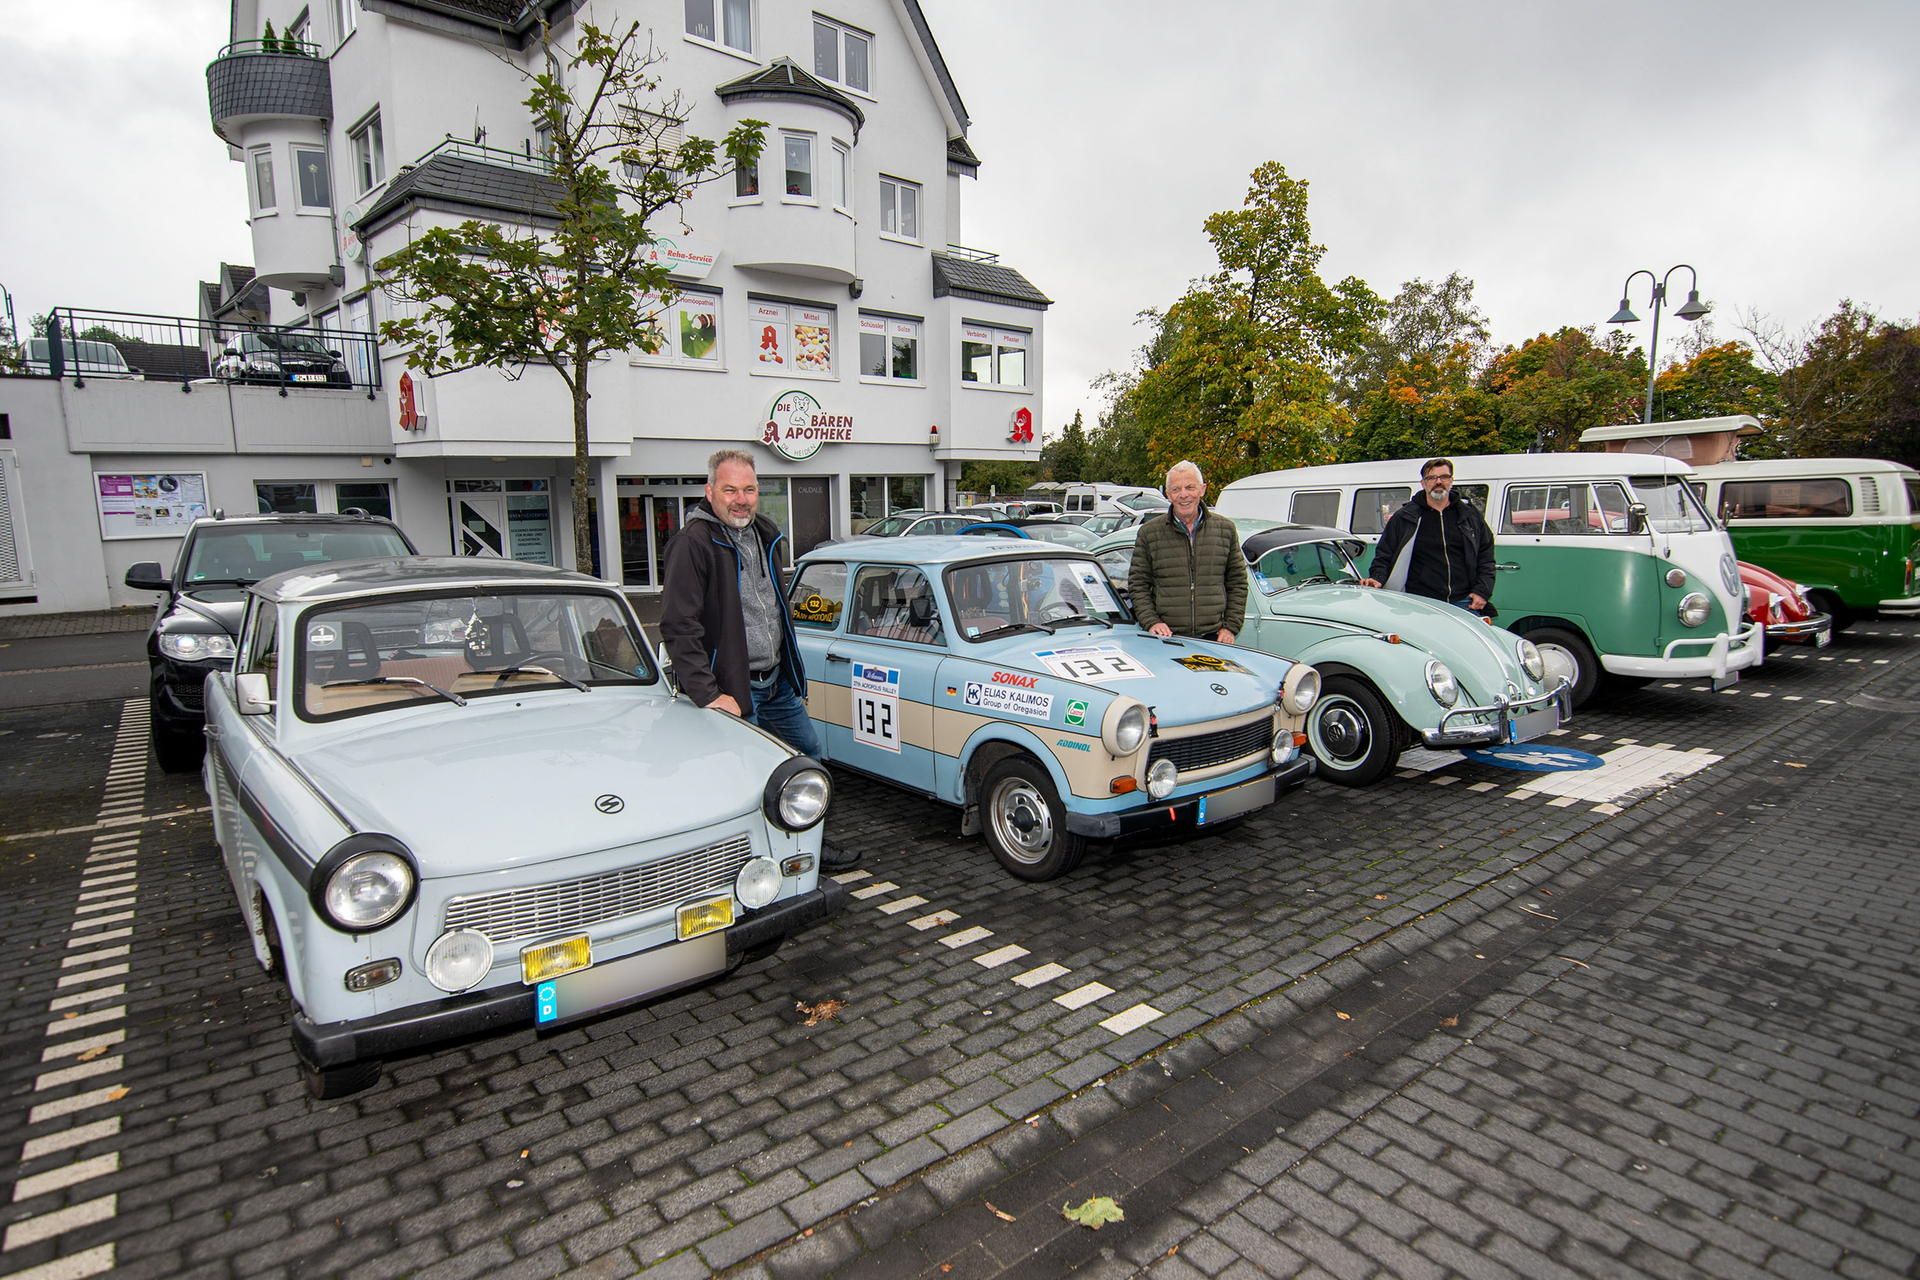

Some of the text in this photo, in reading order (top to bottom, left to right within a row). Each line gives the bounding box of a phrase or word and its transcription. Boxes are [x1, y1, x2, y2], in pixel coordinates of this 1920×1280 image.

[667, 249, 713, 263] Reha-Service
[758, 307, 779, 316] Arznei
[803, 313, 820, 321] Mittel
[777, 403, 791, 412] DIE
[810, 411, 853, 428] BÄREN
[785, 427, 852, 440] APOTHEKE
[794, 443, 817, 457] HEIDEN
[1061, 656, 1136, 678] 132
[991, 671, 1039, 689] SONAX
[983, 687, 1049, 707] ELIAS KALIMOS
[982, 698, 1048, 717] Group of Oregasion
[858, 698, 892, 739] 132
[543, 1005, 552, 1016] D
